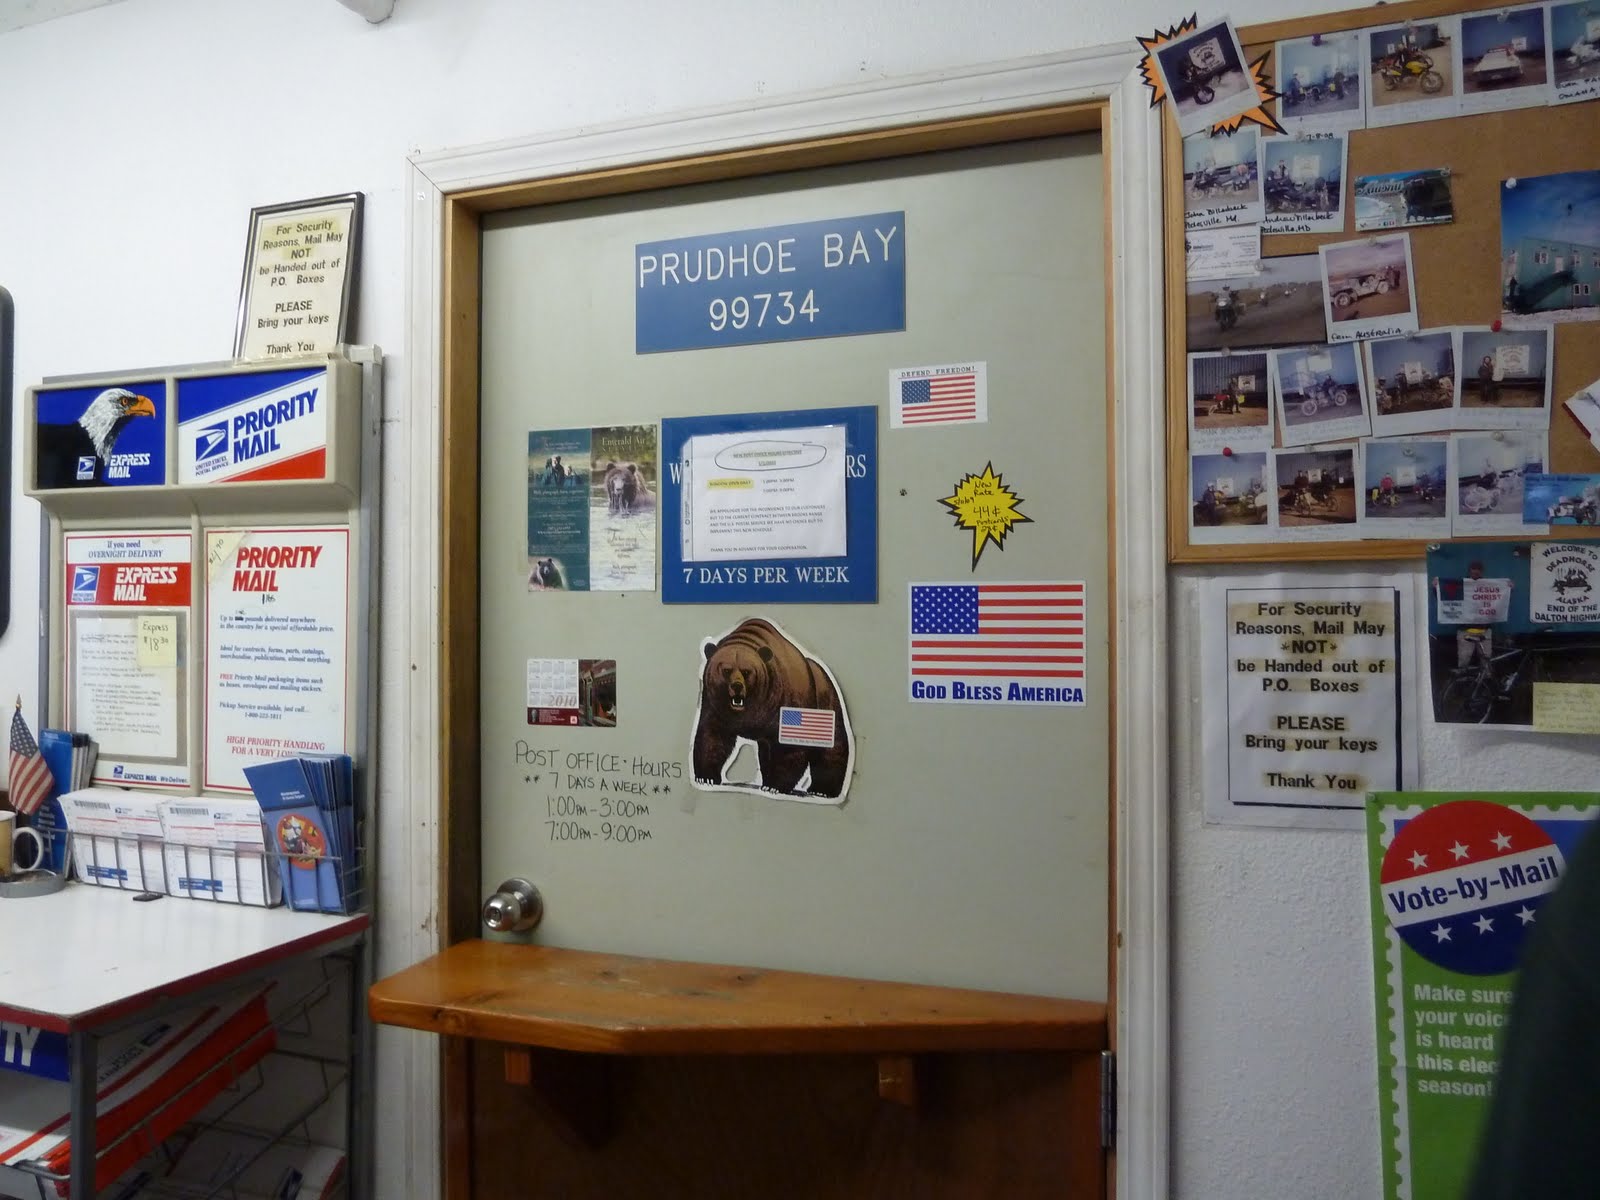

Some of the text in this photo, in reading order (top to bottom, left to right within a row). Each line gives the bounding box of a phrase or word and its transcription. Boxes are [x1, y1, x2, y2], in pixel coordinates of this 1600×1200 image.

[276, 220, 333, 235] For Security
[263, 232, 343, 250] Reasons, Mail May
[291, 248, 311, 259] NOT
[640, 226, 897, 288] PRUDHOE BAY
[259, 258, 341, 275] be Handed out of
[271, 275, 325, 287] P.O. Boxes
[275, 300, 313, 313] PLEASE
[709, 289, 819, 331] 99734
[257, 314, 329, 329] Bring your keys
[266, 341, 315, 354] Thank You
[901, 366, 975, 378] DEFEND FREEDOM!
[233, 387, 318, 439] PRIORITY
[233, 431, 280, 464] MAIL
[110, 453, 151, 466] EXPRESS
[108, 466, 131, 478] MAIL
[126, 540, 141, 548] need
[88, 550, 163, 558] OVERNIGHT DELIVERY
[236, 545, 323, 568] PRIORITY
[1542, 545, 1598, 560] WELCOME TO
[1546, 556, 1595, 572] DEADHORSE
[116, 566, 178, 584] EXPRESS
[232, 570, 278, 592] MAIL
[683, 565, 849, 584] 7 DAYS PER WEEK
[113, 584, 147, 601] MAIL
[1556, 595, 1590, 605] ALASKA
[1258, 601, 1362, 617] For Security
[1547, 604, 1565, 612] END
[1581, 604, 1598, 612] THE
[1535, 611, 1600, 622] DALTON HIGHWA
[143, 621, 169, 634] Express
[1236, 621, 1385, 637] Reasons, Mail May
[1237, 659, 1386, 673] be Handed out of
[1262, 679, 1359, 692] P.O. Boxes
[548, 695, 577, 707] 2010
[1277, 716, 1345, 731] PLEASE
[227, 736, 325, 750] HIGH PRIORITY HANDLING
[1245, 735, 1378, 751] Bring your keys
[232, 746, 246, 754] FOR
[248, 747, 253, 755] A
[256, 748, 276, 757] VERY
[515, 740, 682, 778] POST OFFICE HOURS
[549, 772, 648, 796] 7 DAYS A WEEK
[1267, 773, 1357, 789] Thank You
[1388, 856, 1559, 914] Vote-by-Mail
[1414, 984, 1466, 1002] Make
[1415, 1010, 1457, 1027] your
[1416, 1031, 1494, 1050] is heard
[1416, 1054, 1453, 1072] this
[1418, 1079, 1492, 1097] season!
